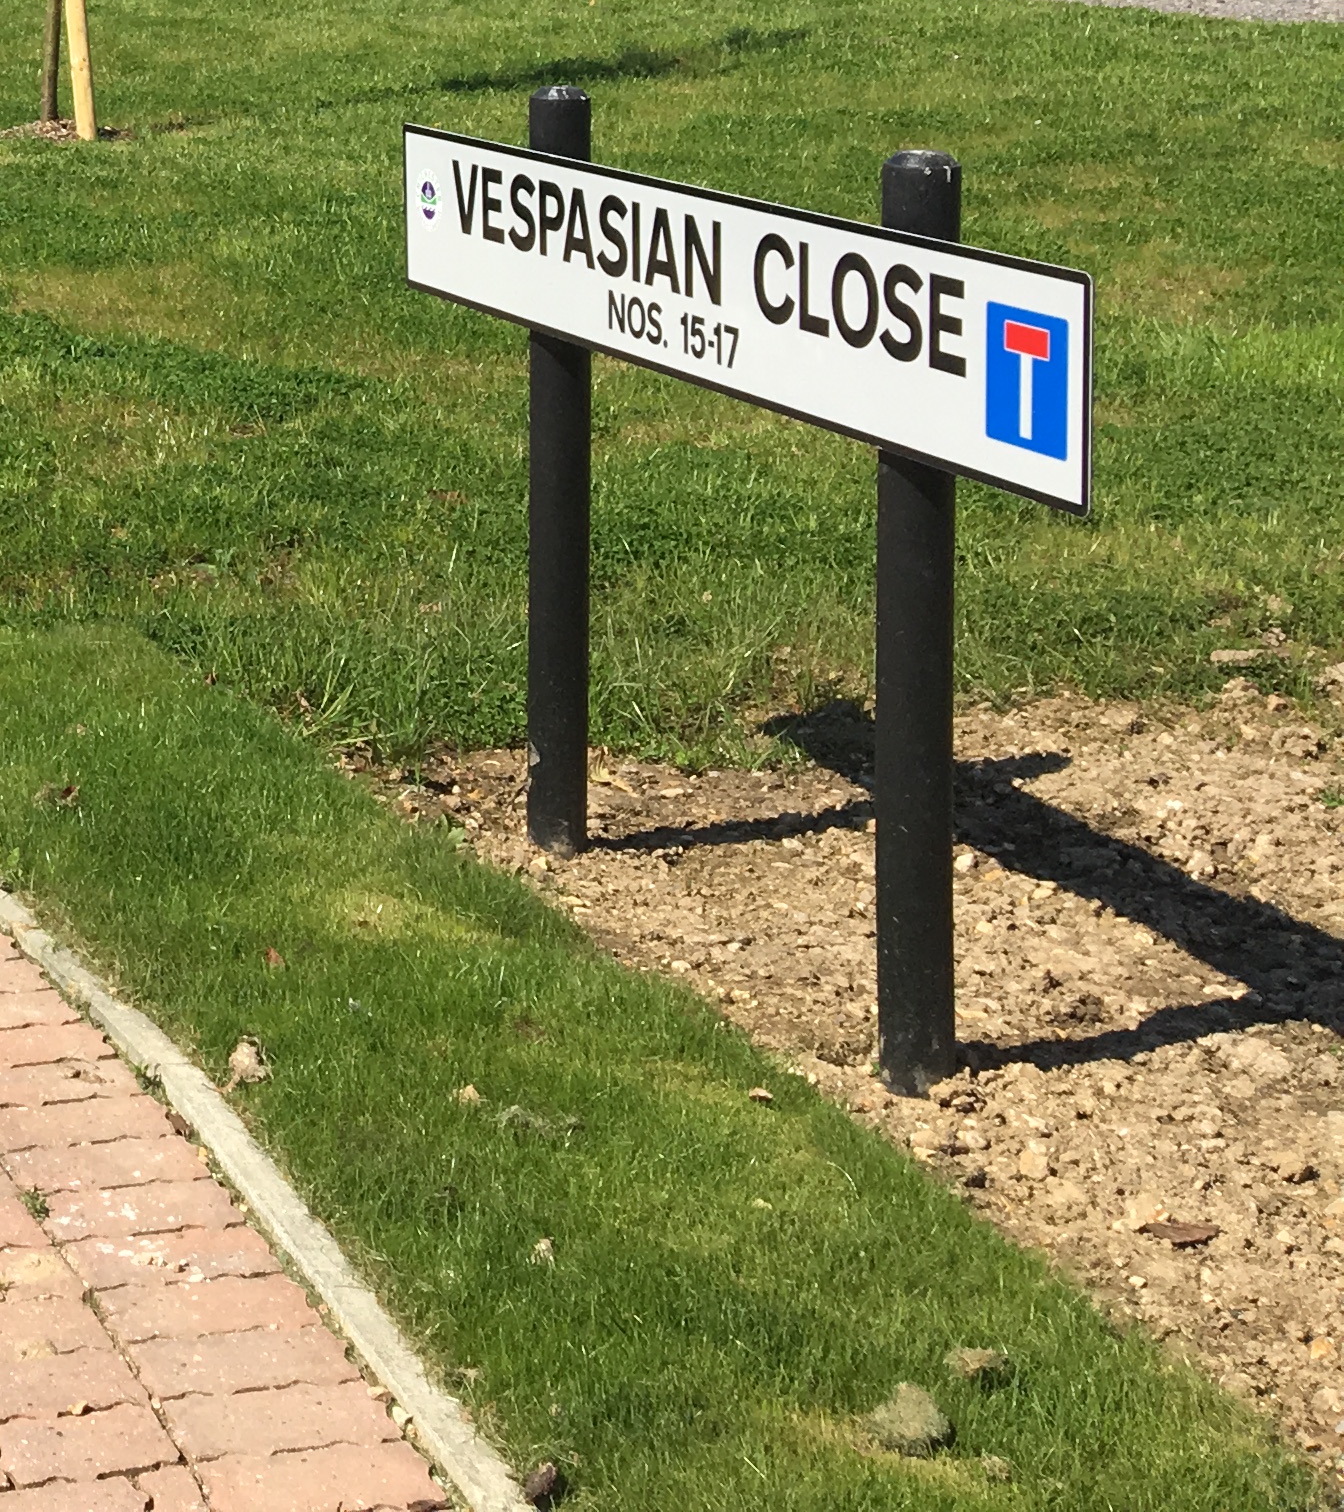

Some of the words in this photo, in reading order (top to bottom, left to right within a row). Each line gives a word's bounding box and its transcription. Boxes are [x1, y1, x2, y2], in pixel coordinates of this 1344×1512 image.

[452, 159, 722, 306] VESPASIAN
[753, 233, 967, 378] CLOSE
[608, 289, 668, 349] NOS.
[680, 312, 739, 369] 15-17
